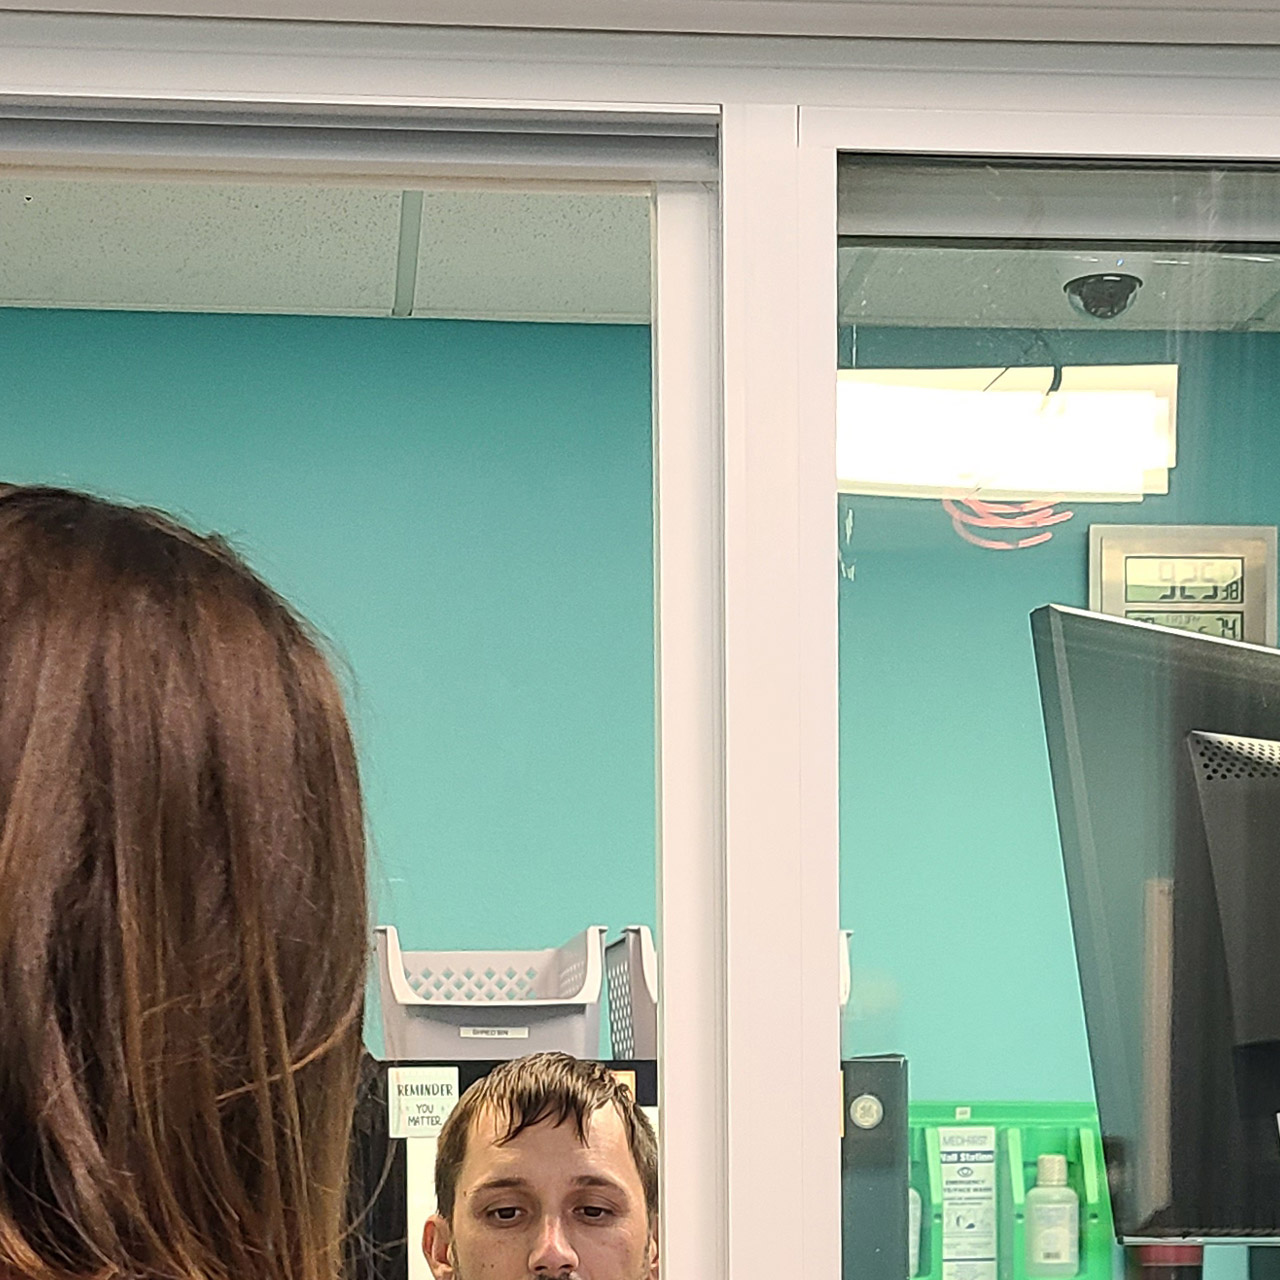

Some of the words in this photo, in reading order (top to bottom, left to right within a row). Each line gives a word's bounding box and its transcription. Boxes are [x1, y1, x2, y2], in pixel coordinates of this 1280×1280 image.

[397, 1084, 453, 1096] REMINDER
[416, 1104, 434, 1114] YOU
[408, 1115, 442, 1126] MATTER
